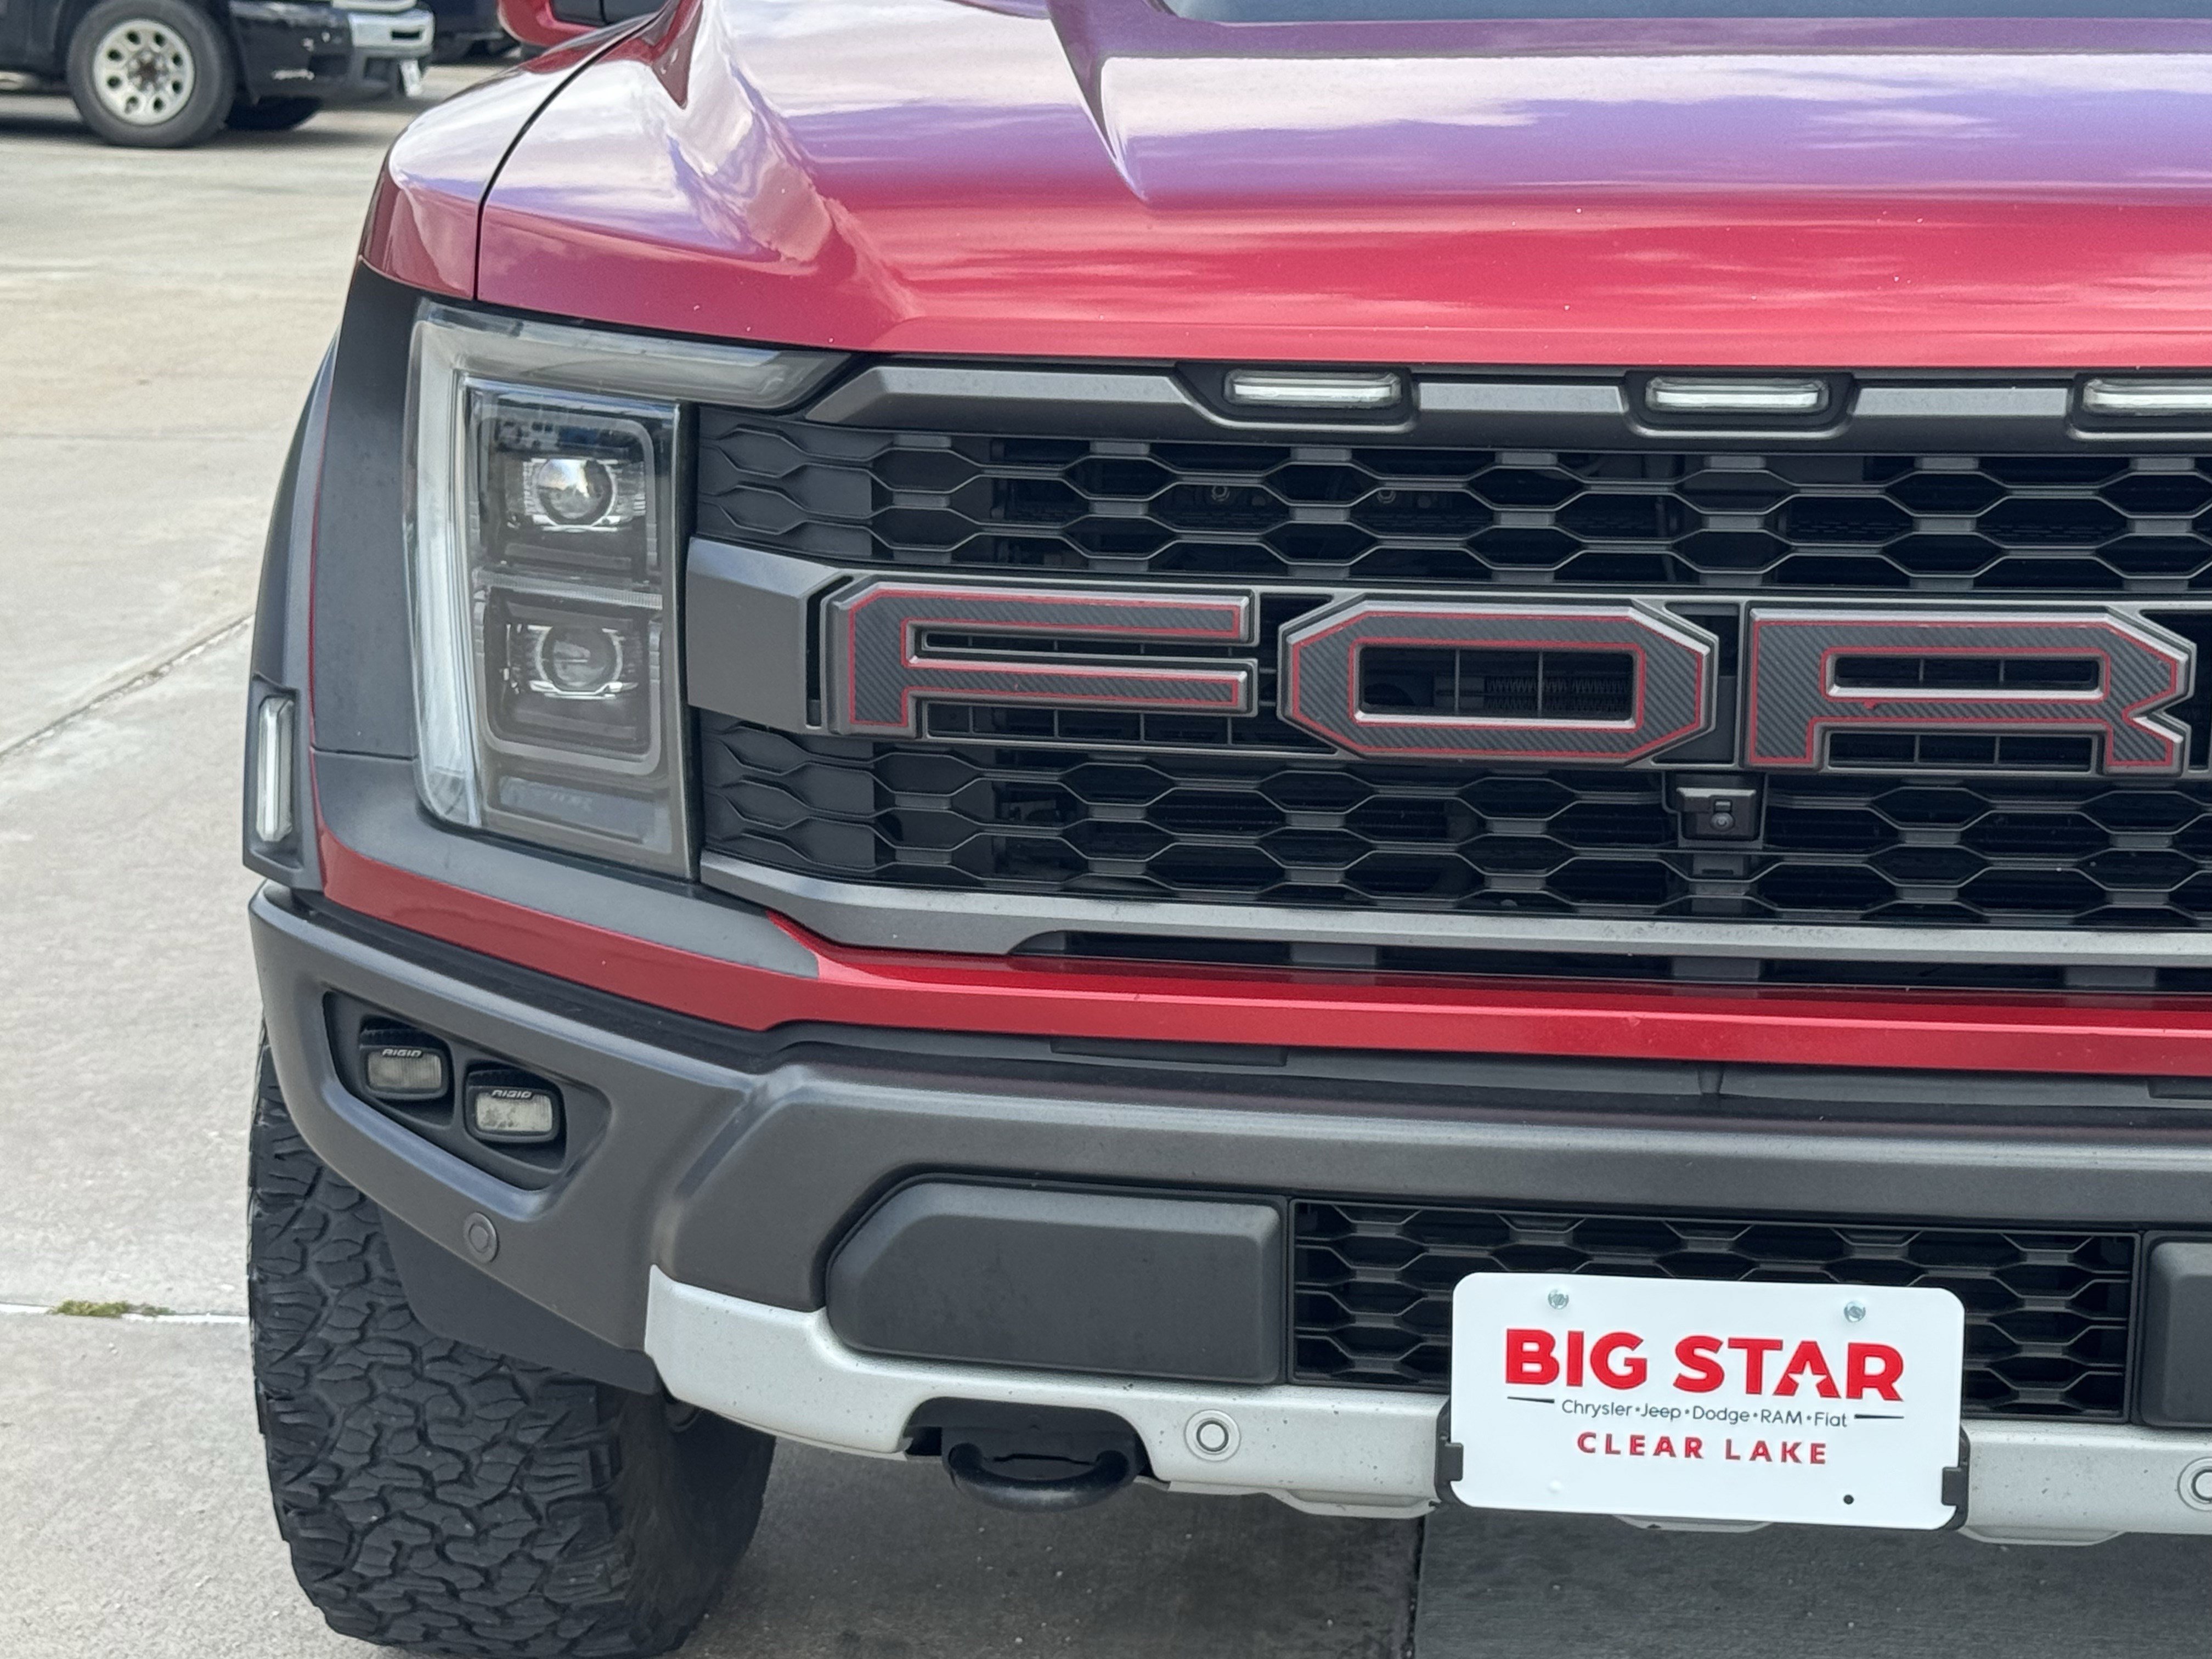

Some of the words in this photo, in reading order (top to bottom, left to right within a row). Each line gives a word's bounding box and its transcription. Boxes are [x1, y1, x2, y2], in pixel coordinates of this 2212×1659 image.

[381, 1048, 422, 1057] RIGID
[1505, 1328, 1648, 1390] BIG
[1672, 1335, 1904, 1402] STAR
[1562, 1399, 1633, 1418] Chrysler
[1640, 1403, 1681, 1421] Jeep
[1692, 1405, 1750, 1425] Dodge
[1760, 1409, 1802, 1425] RAM
[1577, 1431, 1703, 1459] CLEAR
[1725, 1438, 1826, 1465] LAKE
